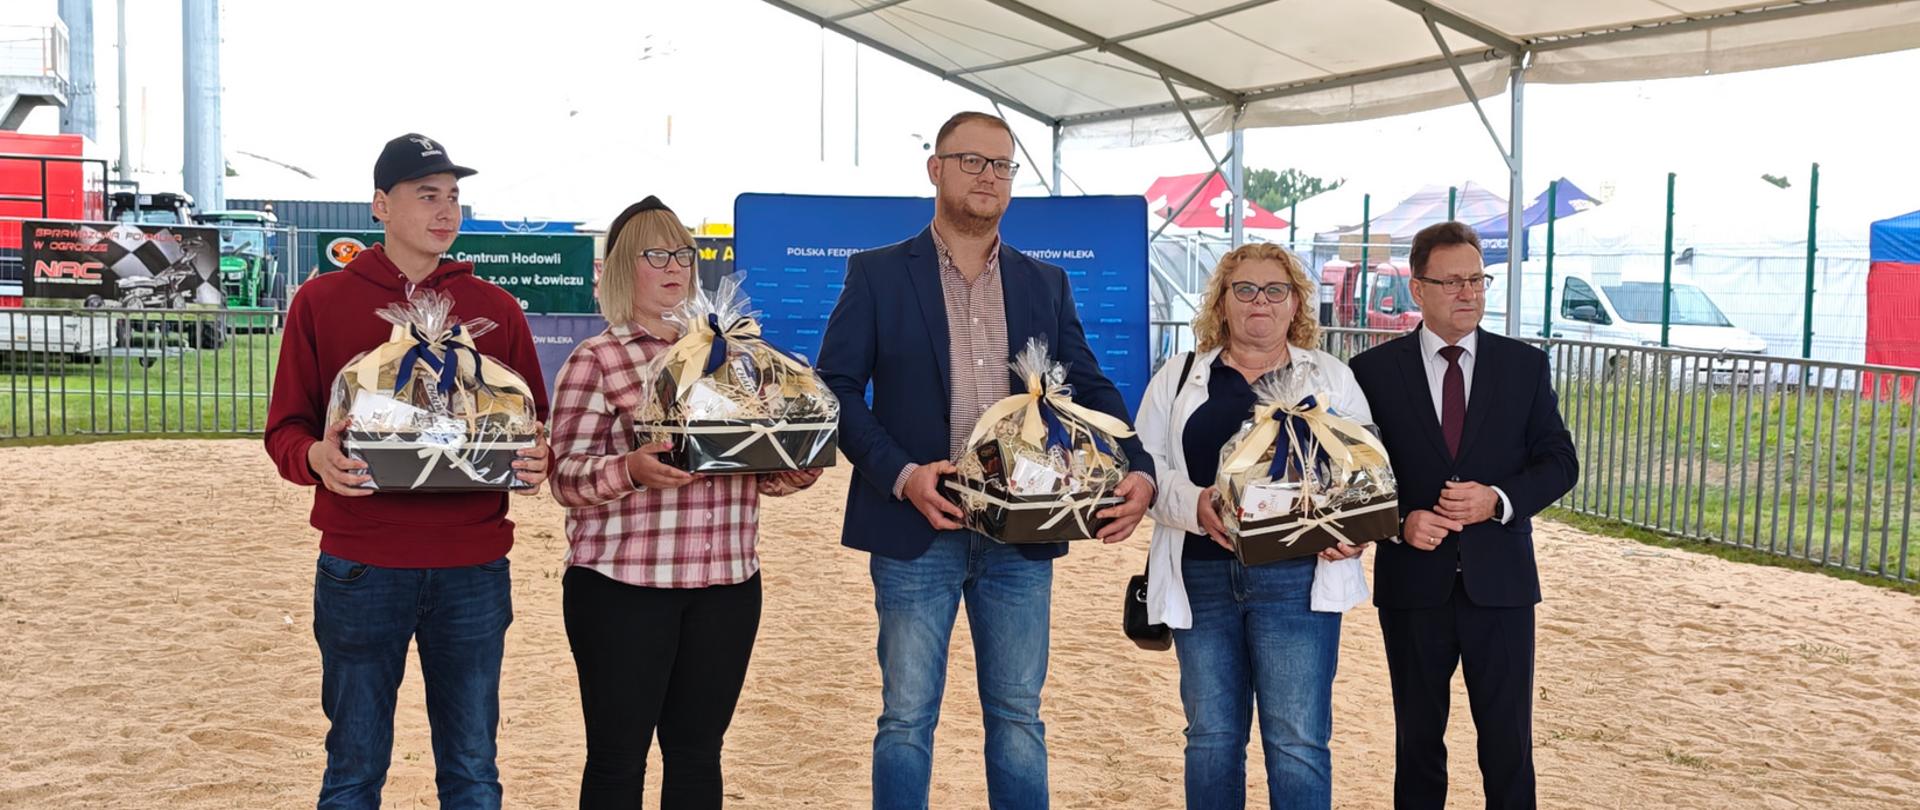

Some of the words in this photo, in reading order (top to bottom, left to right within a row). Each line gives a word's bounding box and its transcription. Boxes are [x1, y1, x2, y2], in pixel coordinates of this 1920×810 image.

[33, 241, 44, 250] W
[787, 247, 825, 256] POLSKA
[1063, 250, 1095, 259] MLEKA
[456, 251, 509, 263] Centrum
[512, 252, 561, 264] Hodowli
[34, 260, 105, 279] NAC
[521, 276, 532, 285] w
[534, 274, 584, 286] Łowiczu
[547, 336, 574, 344] MLEKA
